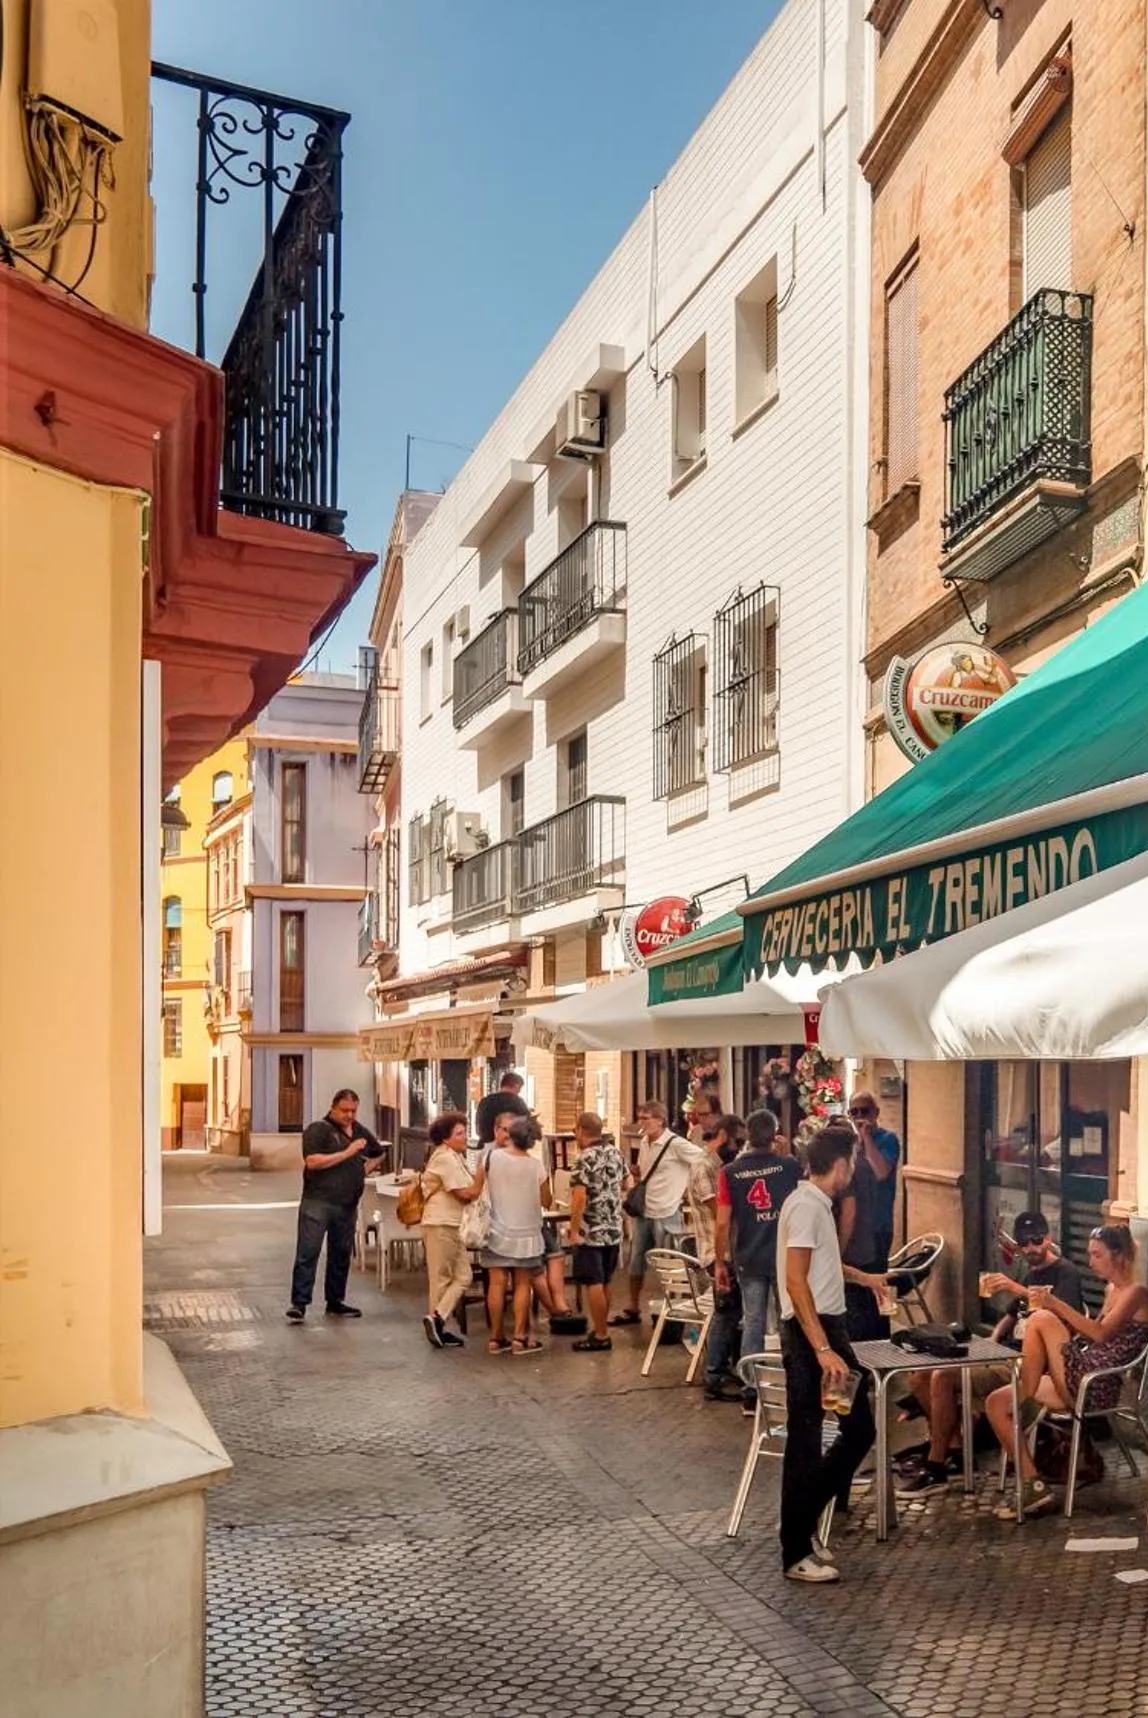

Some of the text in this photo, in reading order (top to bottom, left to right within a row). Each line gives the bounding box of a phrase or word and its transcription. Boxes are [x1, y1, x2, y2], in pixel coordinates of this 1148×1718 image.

[919, 688, 997, 708] Cruzcam
[760, 828, 1098, 962] CERVECERIA EL TREMENDO
[637, 928, 680, 945] Cruzc
[747, 1178, 772, 1210] 4
